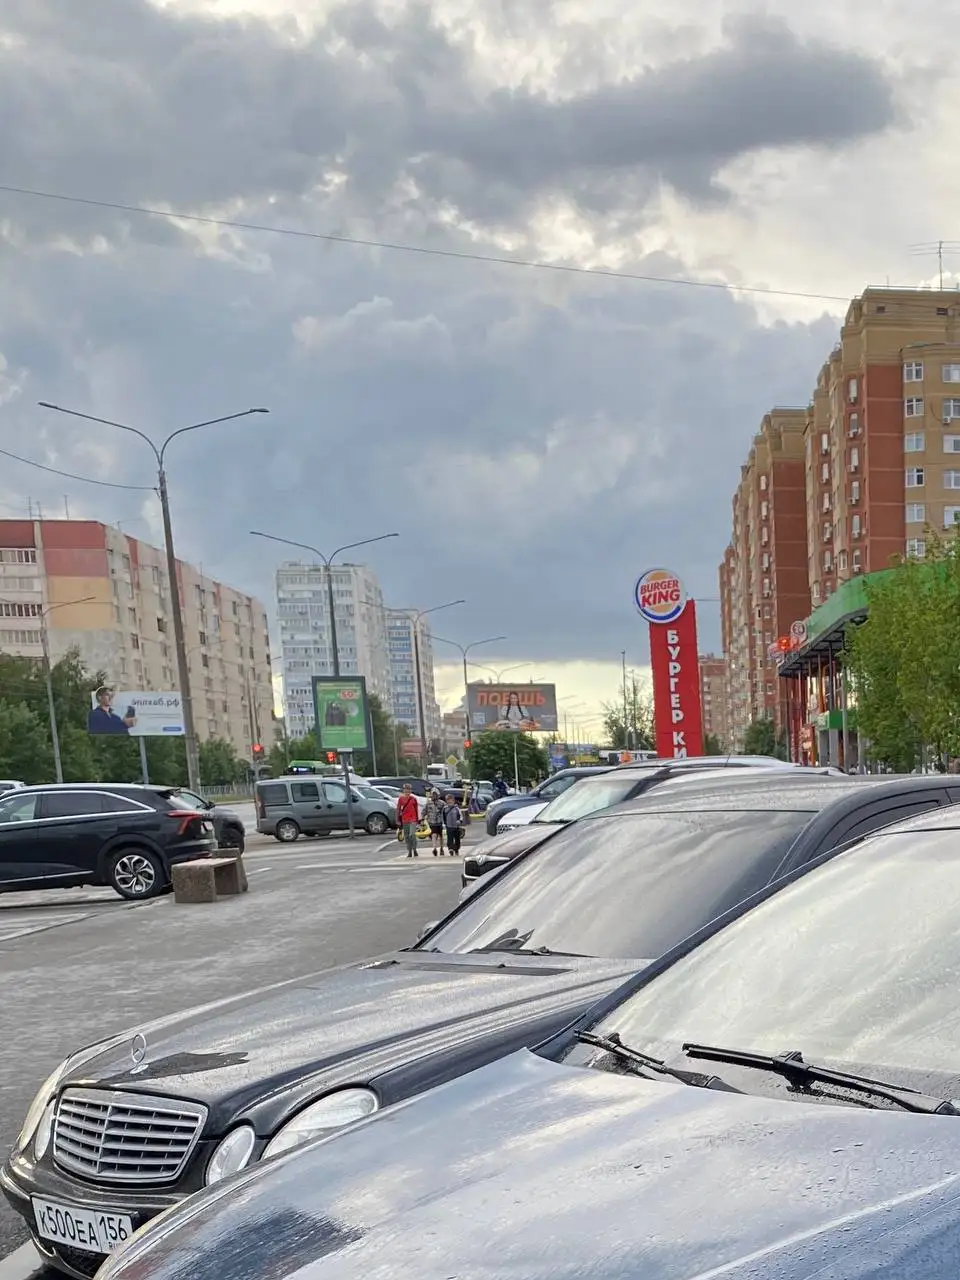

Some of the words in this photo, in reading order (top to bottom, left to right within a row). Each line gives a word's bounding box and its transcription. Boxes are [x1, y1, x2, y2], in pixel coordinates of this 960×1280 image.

[640, 579, 679, 594] BURGER
[641, 589, 681, 608] KING
[666, 629, 684, 724] БУРГЕР
[38, 1205, 99, 1247] К500ЕА
[99, 1216, 128, 1242] 156
